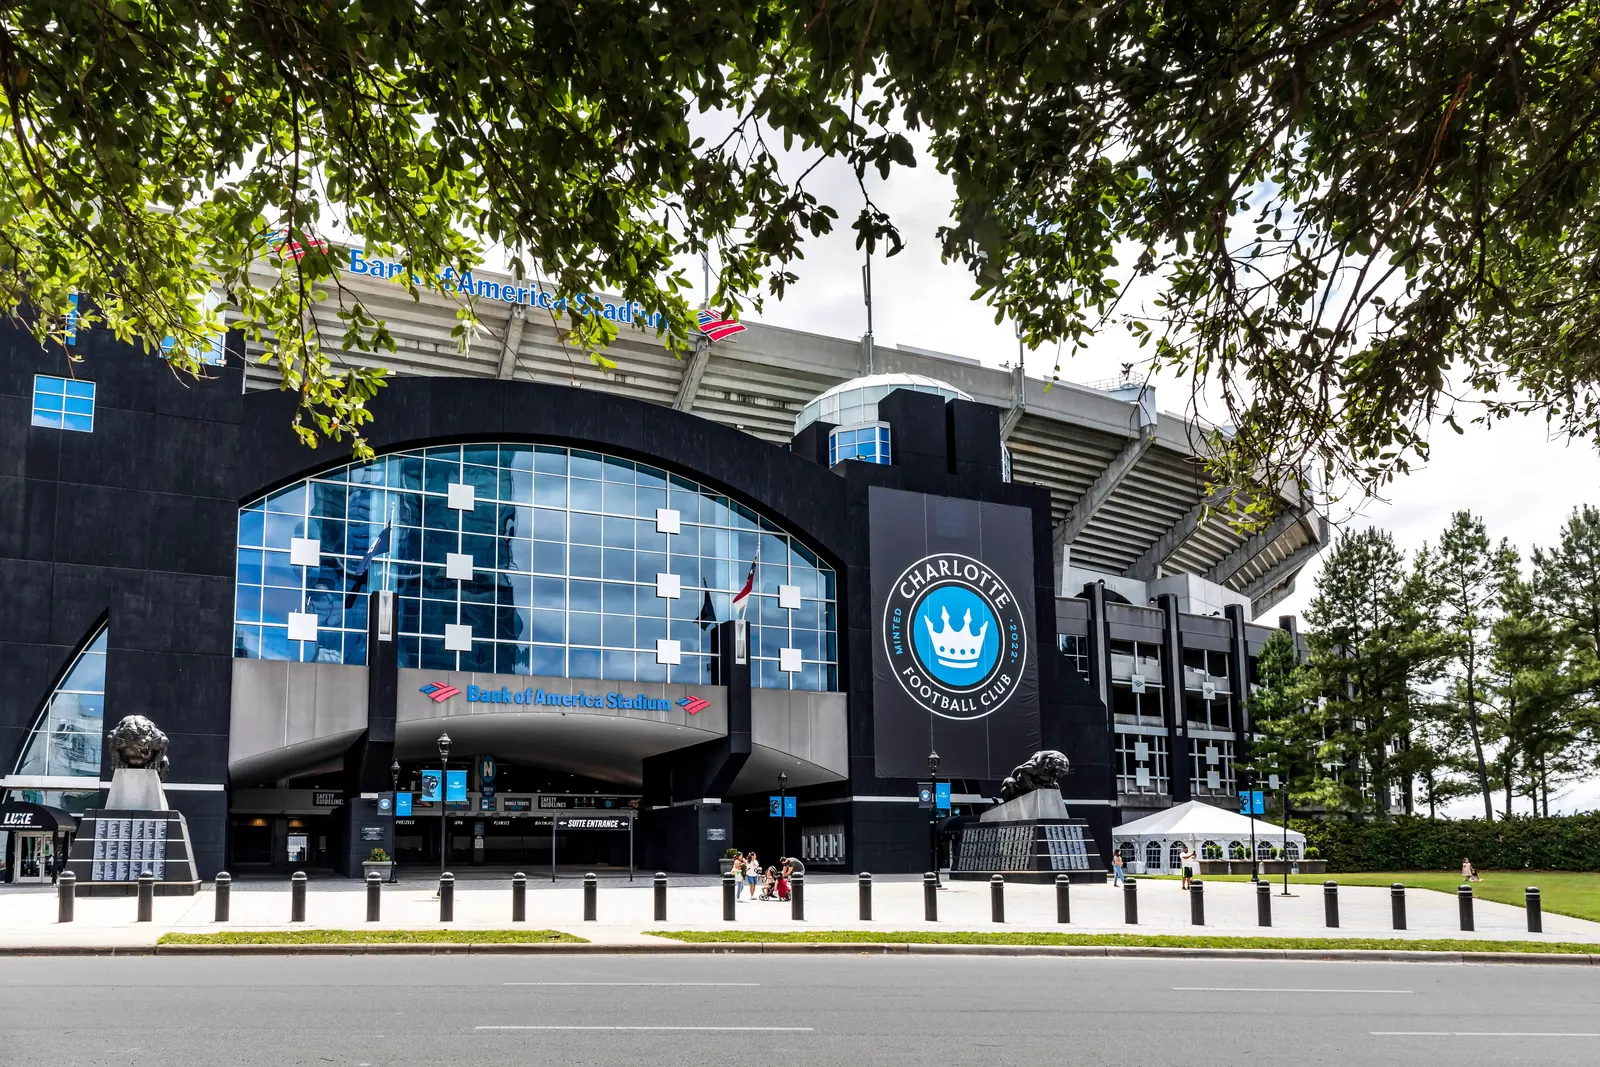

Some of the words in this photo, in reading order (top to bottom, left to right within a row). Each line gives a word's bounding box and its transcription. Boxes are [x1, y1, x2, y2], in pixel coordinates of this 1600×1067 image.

[350, 249, 420, 285] Ban
[457, 270, 568, 313] America
[900, 559, 1011, 610] CHARLOTTE
[892, 607, 903, 655] MINTED
[467, 685, 514, 704] Bank
[514, 687, 534, 705] of
[534, 689, 604, 708] America
[606, 692, 671, 711] Stadium
[903, 666, 977, 712] FOOTBALL
[980, 673, 1011, 706] CLUB
[483, 761, 493, 777] N
[3, 812, 34, 824] LUXE
[567, 819, 586, 828] SUITE
[586, 819, 619, 828] ENTRANCE
